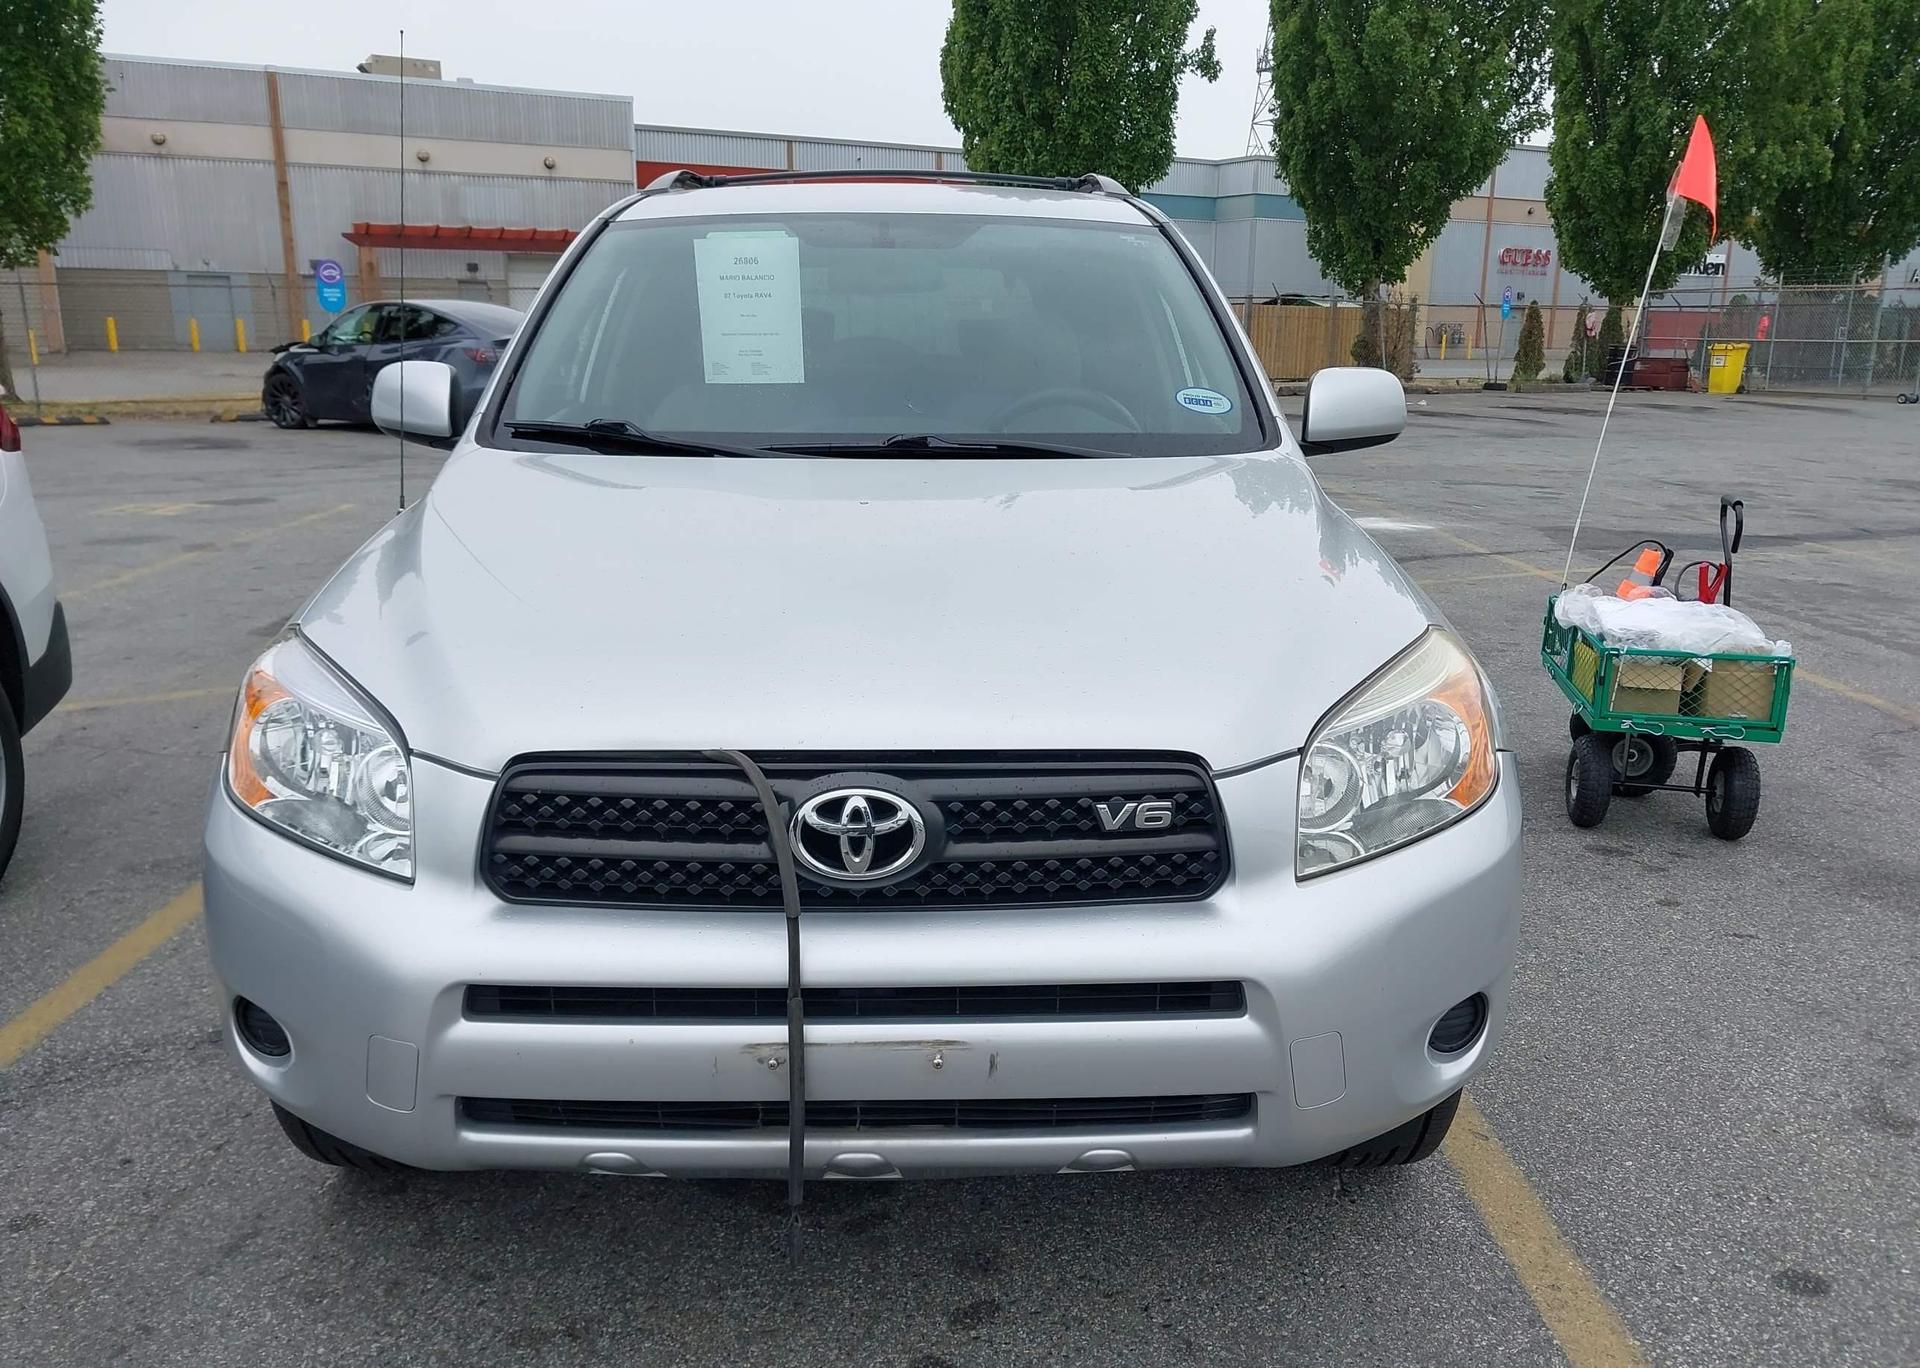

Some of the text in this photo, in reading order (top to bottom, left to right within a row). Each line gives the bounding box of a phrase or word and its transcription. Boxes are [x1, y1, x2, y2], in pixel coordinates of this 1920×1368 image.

[733, 256, 759, 265] 26806
[1499, 248, 1551, 267] GUESS
[733, 292, 753, 300] Toyota
[1096, 802, 1172, 830] V6
